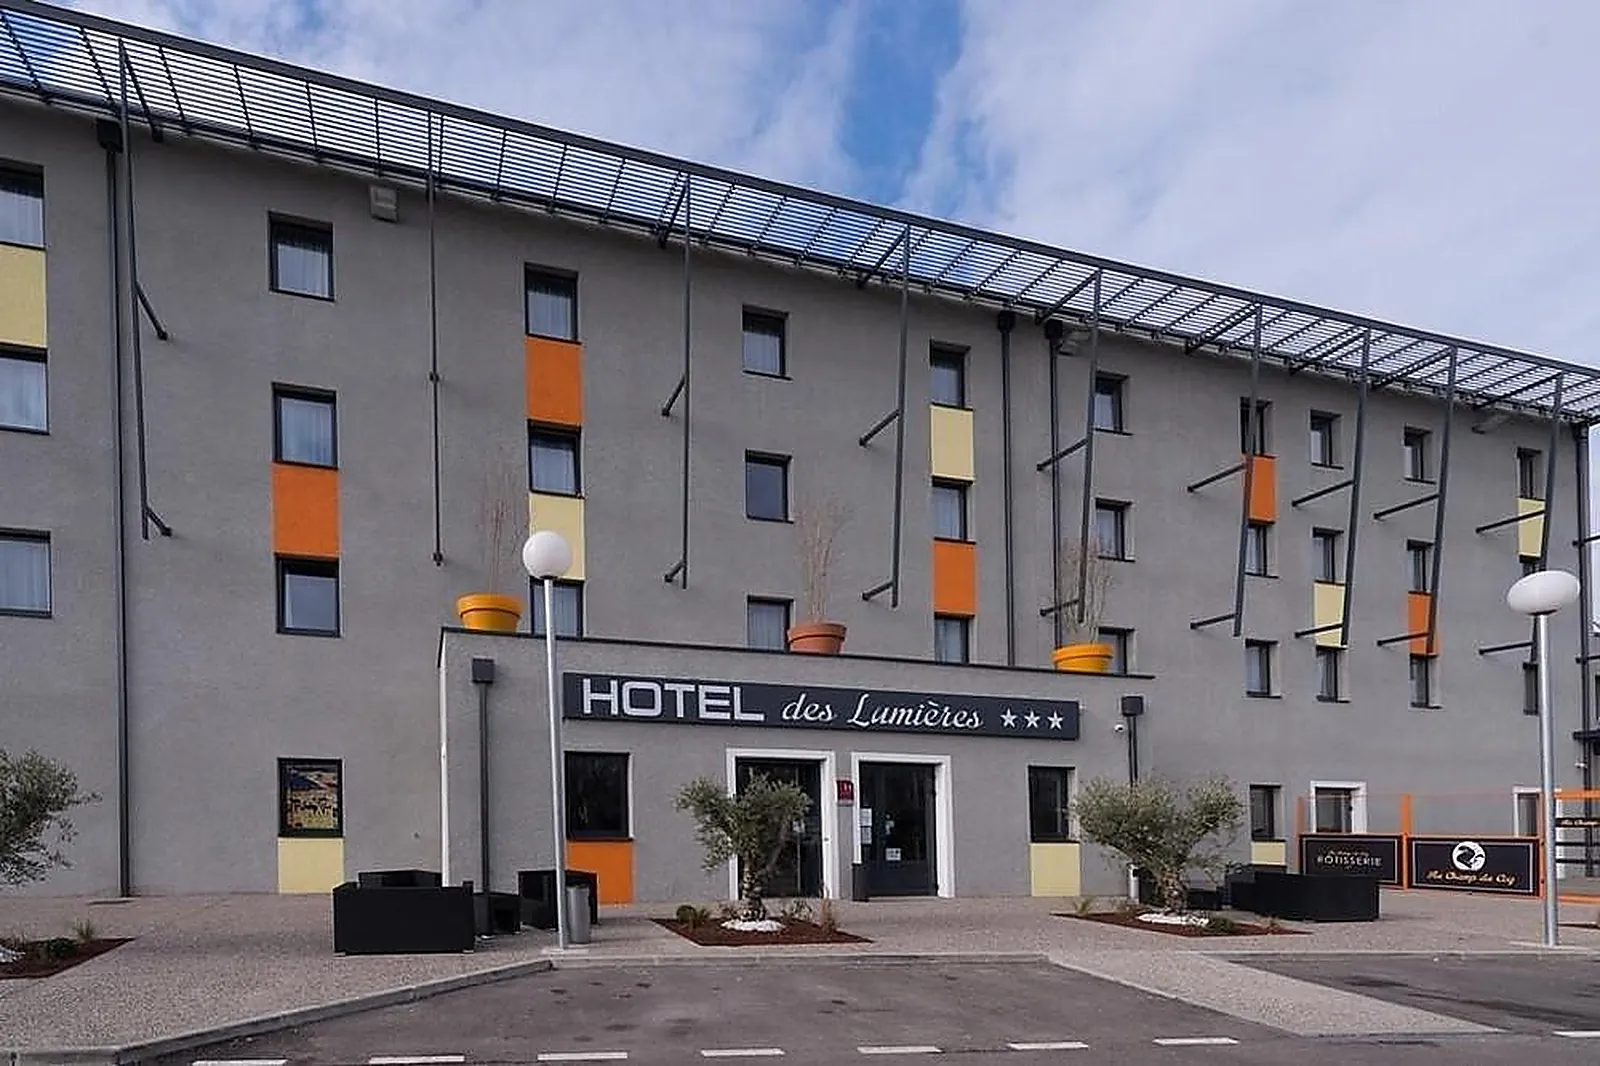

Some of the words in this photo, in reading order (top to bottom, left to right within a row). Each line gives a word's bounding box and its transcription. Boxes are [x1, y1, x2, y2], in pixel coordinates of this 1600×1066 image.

[582, 678, 765, 722] HOTEL
[782, 693, 837, 722] des
[847, 693, 983, 728] Lumières
